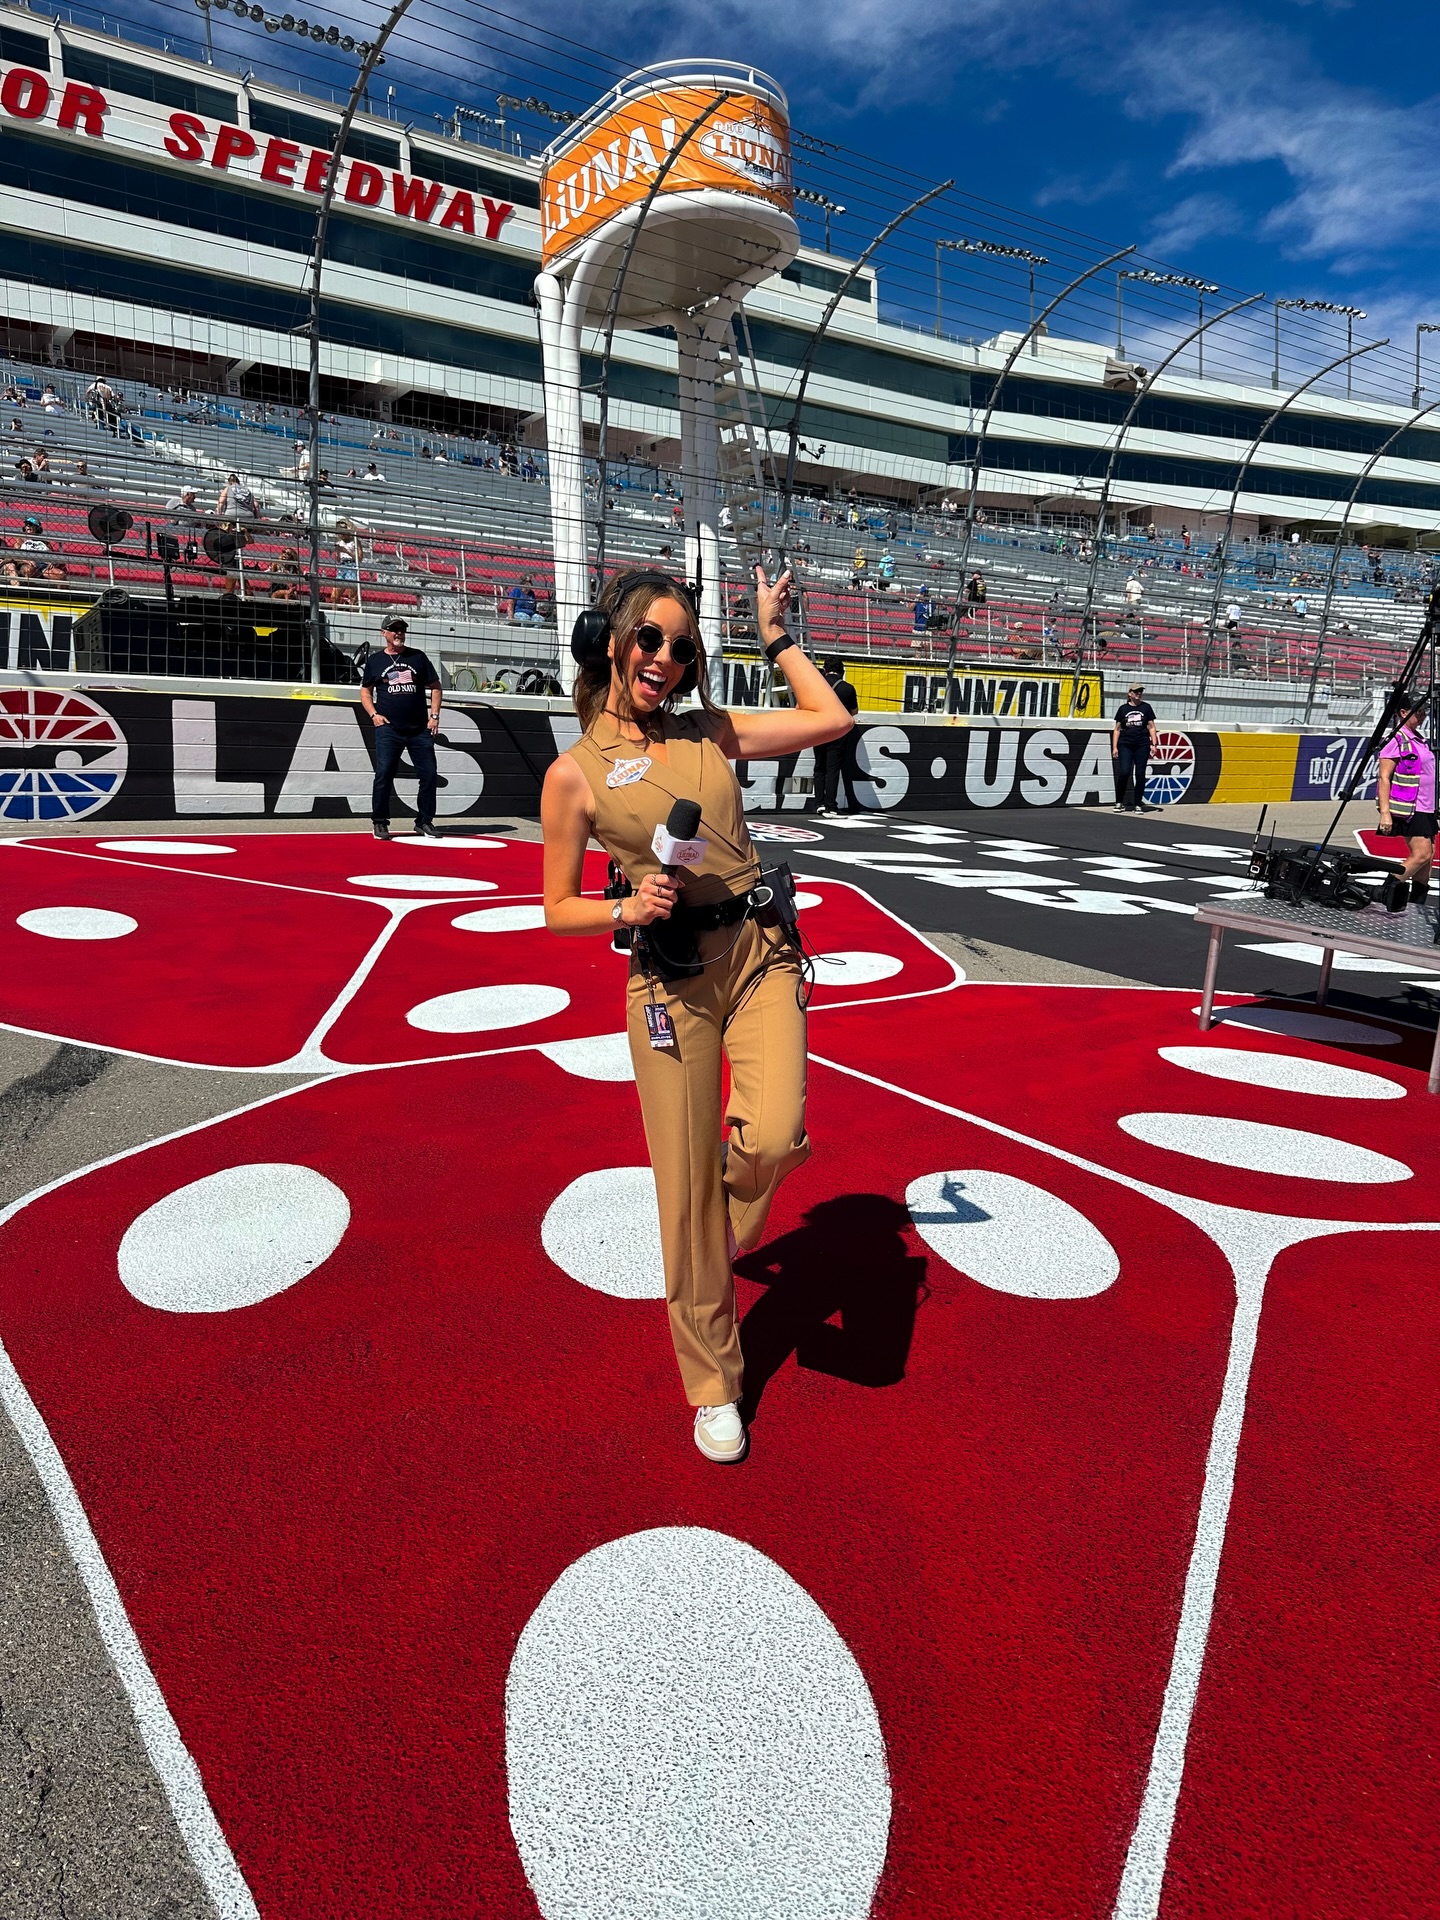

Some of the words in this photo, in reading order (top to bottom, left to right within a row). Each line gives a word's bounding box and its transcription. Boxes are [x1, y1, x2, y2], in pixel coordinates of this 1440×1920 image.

[715, 122, 744, 134] THE
[163, 113, 514, 240] SPEEDWAY
[387, 685, 401, 693] OLD
[401, 684, 417, 693] NAVY
[172, 699, 484, 815] LAS
[964, 730, 1117, 809] USA
[1309, 757, 1334, 783] LAS
